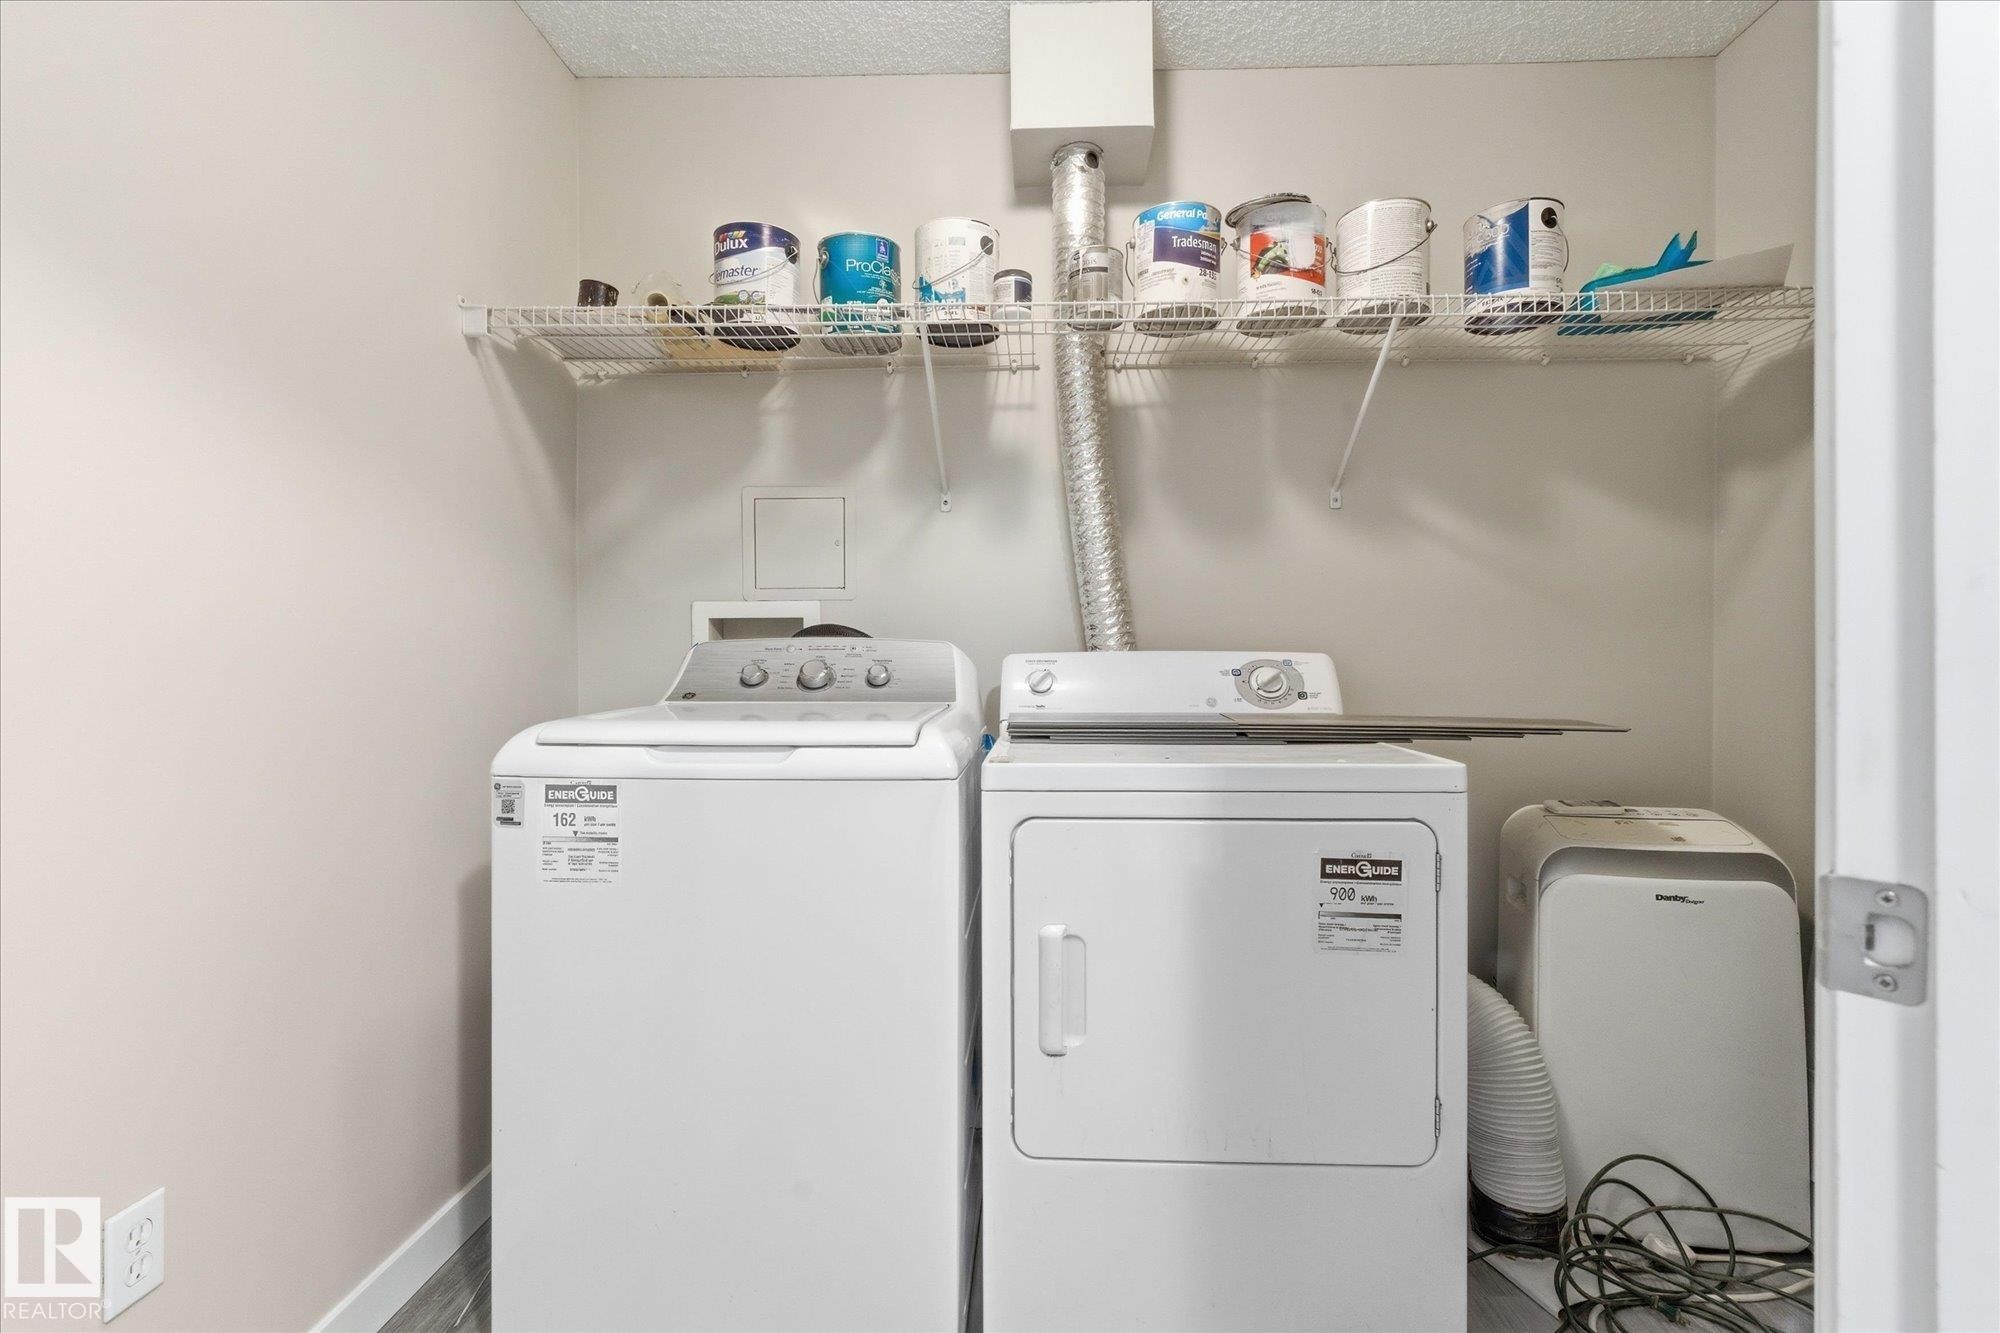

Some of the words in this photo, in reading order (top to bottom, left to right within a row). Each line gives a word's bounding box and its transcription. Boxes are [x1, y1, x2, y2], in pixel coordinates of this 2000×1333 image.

[1157, 208, 1195, 221] General
[714, 238, 749, 255] Dulux
[1172, 235, 1217, 252] Tradesman
[548, 786, 614, 801] ENERGUIDE
[553, 812, 576, 827] 162
[1325, 861, 1399, 878] ENERGUIDE
[1330, 887, 1356, 901] 900
[1655, 894, 1688, 903] Danby
